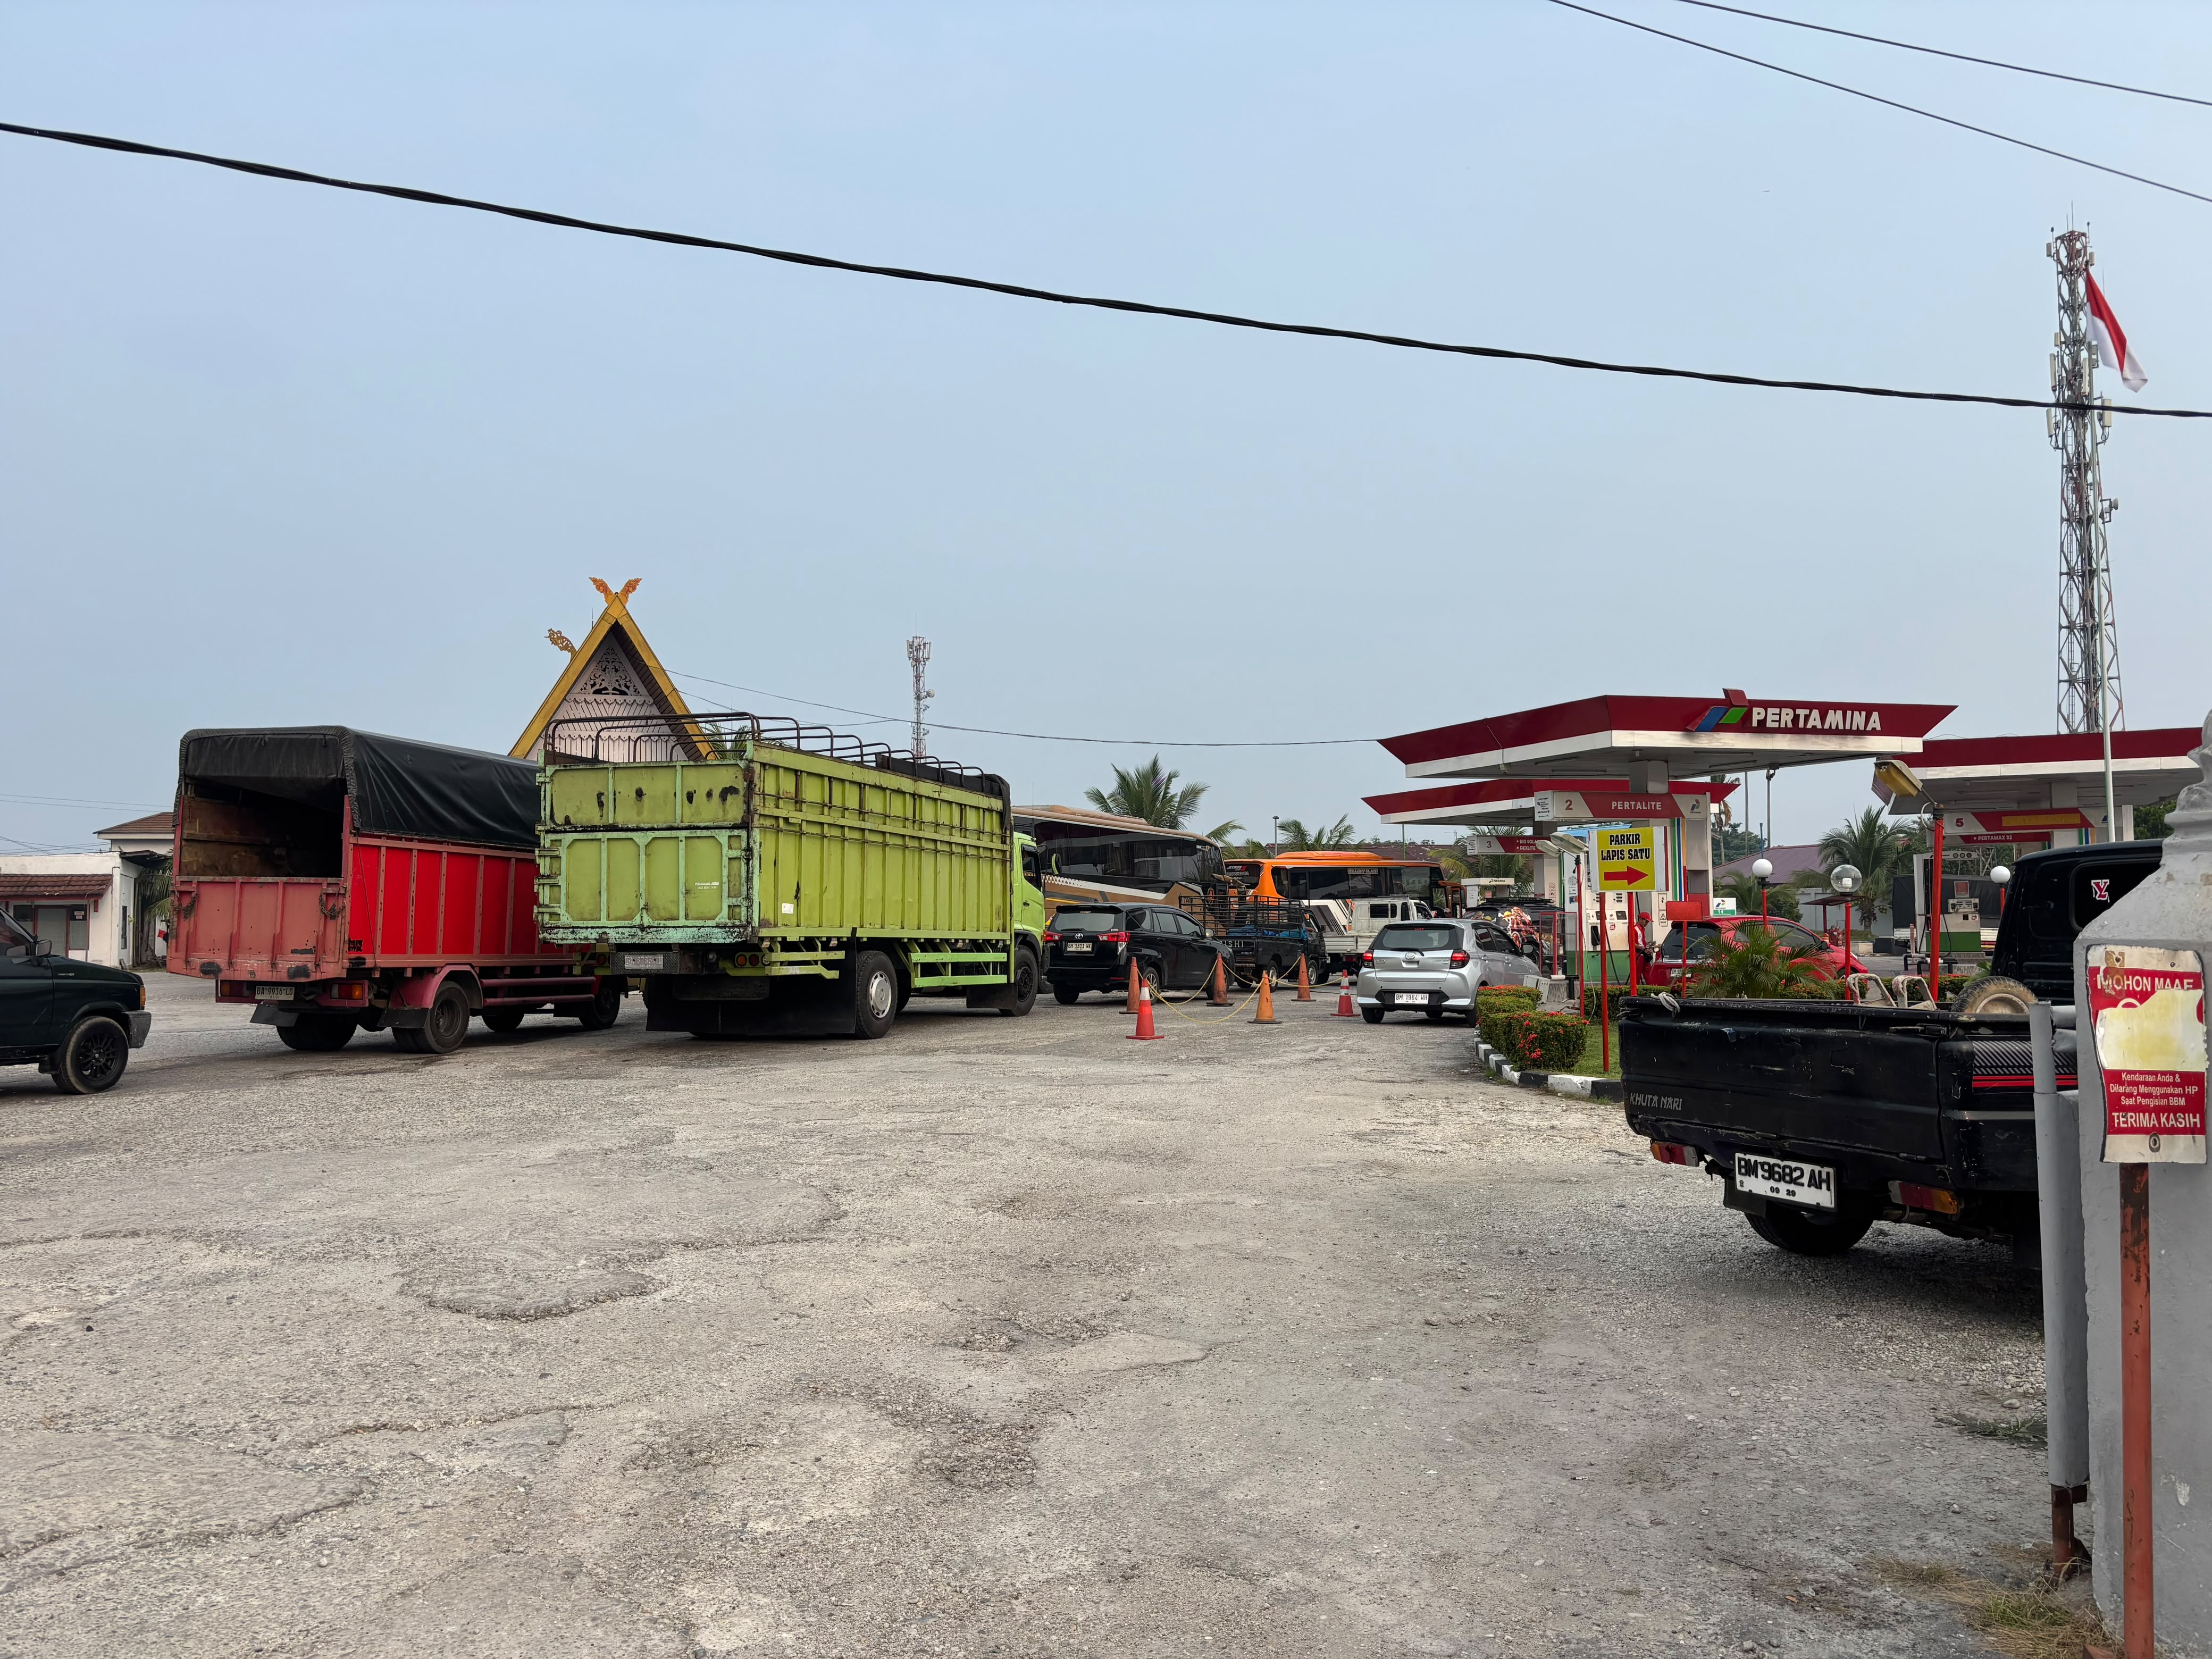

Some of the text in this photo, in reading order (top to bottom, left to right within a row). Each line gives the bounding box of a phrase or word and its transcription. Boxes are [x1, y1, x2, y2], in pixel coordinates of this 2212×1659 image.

[1752, 707, 1881, 731] PERTAMINA
[1565, 799, 1573, 811] 2
[1612, 801, 1662, 810] PERTALITE
[1955, 818, 1964, 827] 5
[1609, 833, 1641, 845] PARKIR
[1601, 848, 1650, 861] LAPIS SATU
[2122, 1072, 2156, 1082] Kendaraan
[2157, 1073, 2173, 1082] Anda
[2110, 1084, 2198, 1095] Dilarang Menggunakan HP
[1630, 1093, 1682, 1111] KHUTA NARI
[2121, 1096, 2185, 1107] Saat Pengisian BBM
[2112, 1112, 2200, 1128] TERIMA KASIH
[1738, 1157, 1831, 1192] BM 9682 AH
